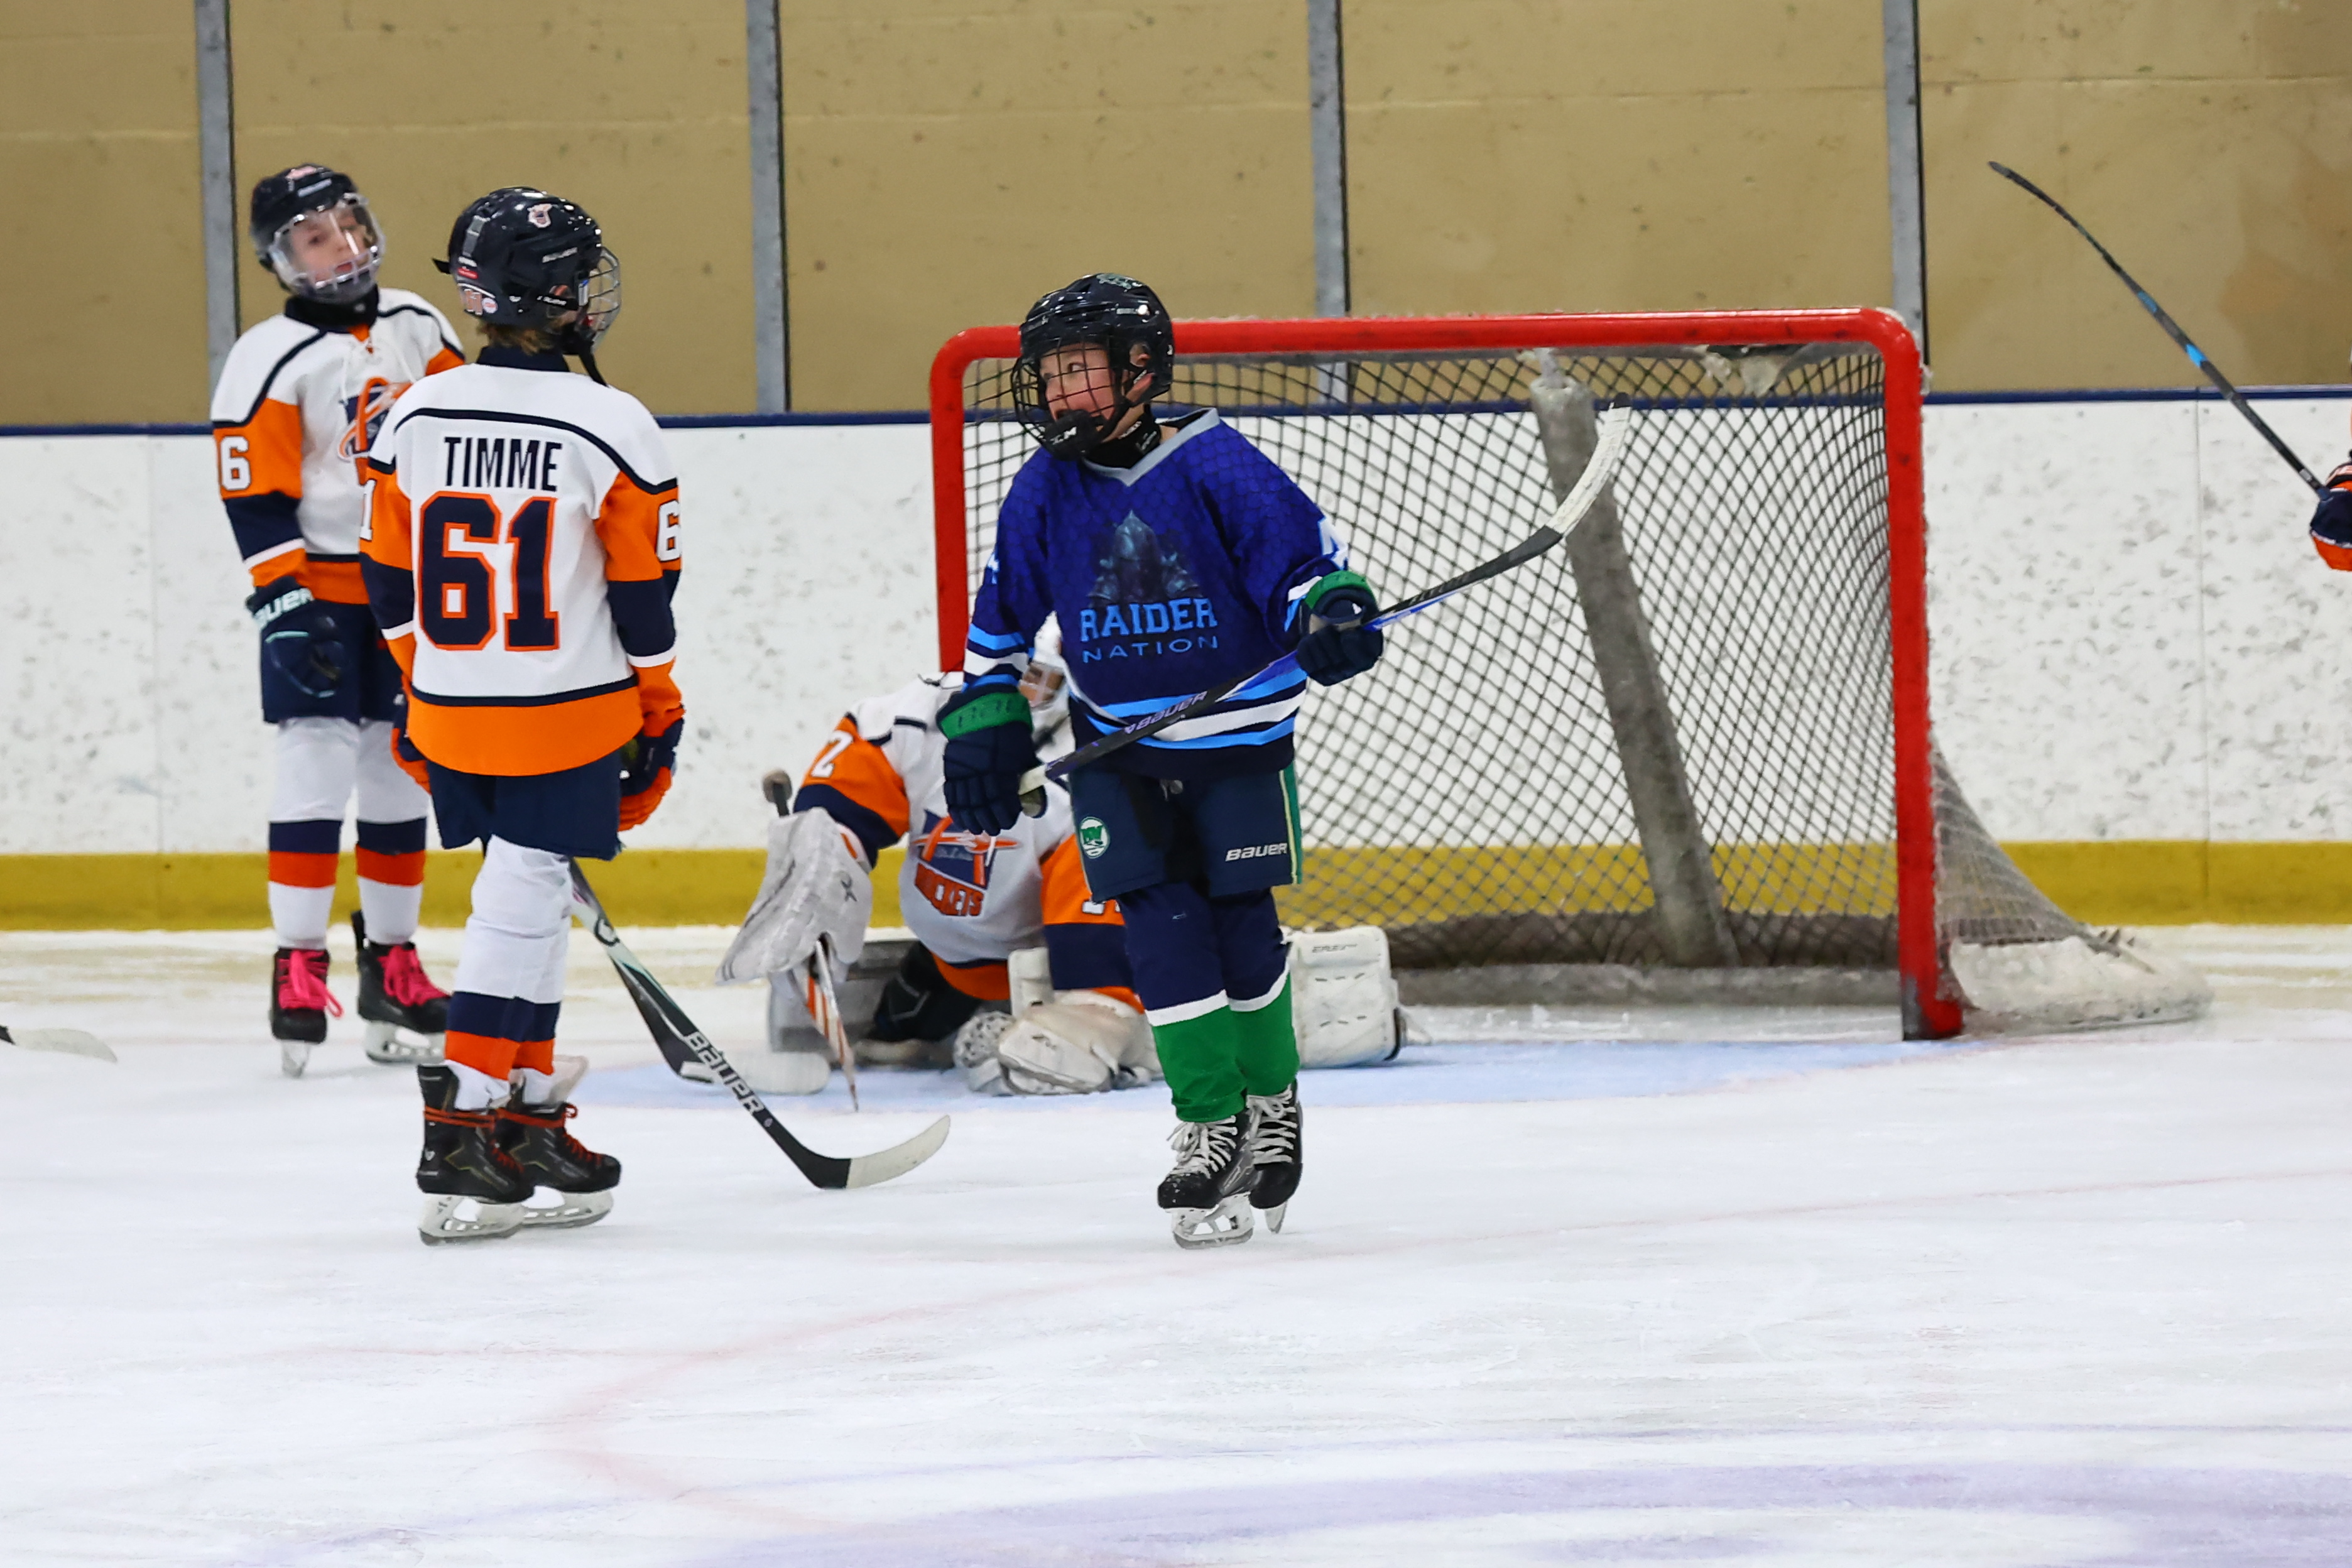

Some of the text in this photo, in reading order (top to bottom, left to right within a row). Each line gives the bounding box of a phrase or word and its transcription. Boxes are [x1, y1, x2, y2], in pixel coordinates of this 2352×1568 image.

[219, 435, 251, 491] 6
[444, 437, 562, 492] TIMME
[655, 499, 682, 563] 6
[417, 491, 560, 652] 61
[252, 587, 314, 628] AUER
[1080, 598, 1217, 642] RAIDER
[1082, 635, 1218, 663] NATION
[810, 730, 853, 778] 2
[1225, 842, 1288, 862] BAUER
[685, 1031, 765, 1116] BAUER
